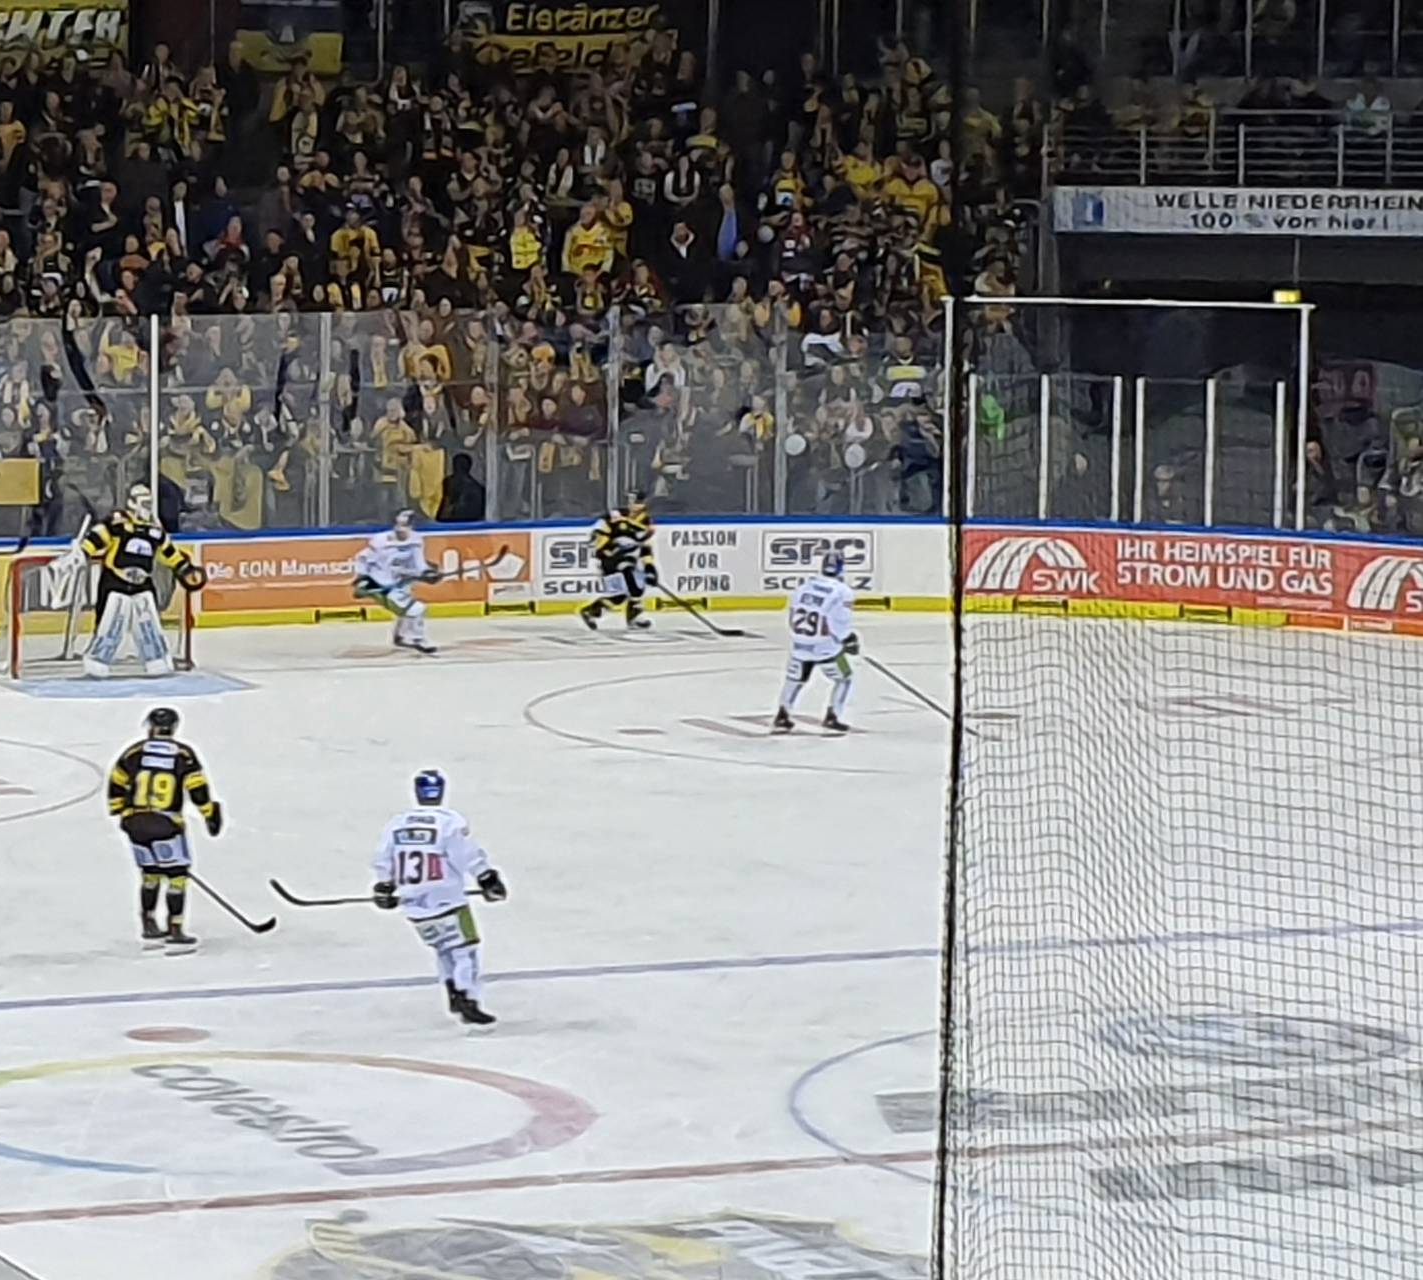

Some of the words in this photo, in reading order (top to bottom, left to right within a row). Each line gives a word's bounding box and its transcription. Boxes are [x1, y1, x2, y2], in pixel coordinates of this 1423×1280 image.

[1155, 193, 1238, 210] WELLE
[1248, 194, 1423, 211] NIEDERRHEIN
[1190, 212, 1234, 229] 100
[1273, 215, 1318, 229] von
[671, 530, 737, 548] PASSION
[769, 537, 866, 566] SPC
[689, 552, 719, 570] FOR
[1117, 538, 1157, 560] IHR
[1167, 541, 1281, 567] HEIMSPIEL
[1288, 544, 1331, 569] FÜR
[206, 561, 235, 580] Die
[281, 558, 358, 577] Mannsch
[1031, 567, 1102, 595] SWK
[1117, 562, 1211, 589] STROM
[1218, 566, 1275, 592] UND
[1281, 571, 1333, 597] GAS
[544, 580, 605, 596] SCHU
[677, 574, 732, 593] PIPING
[793, 608, 819, 637] 29
[133, 770, 177, 810] 19
[398, 850, 424, 886] 13
